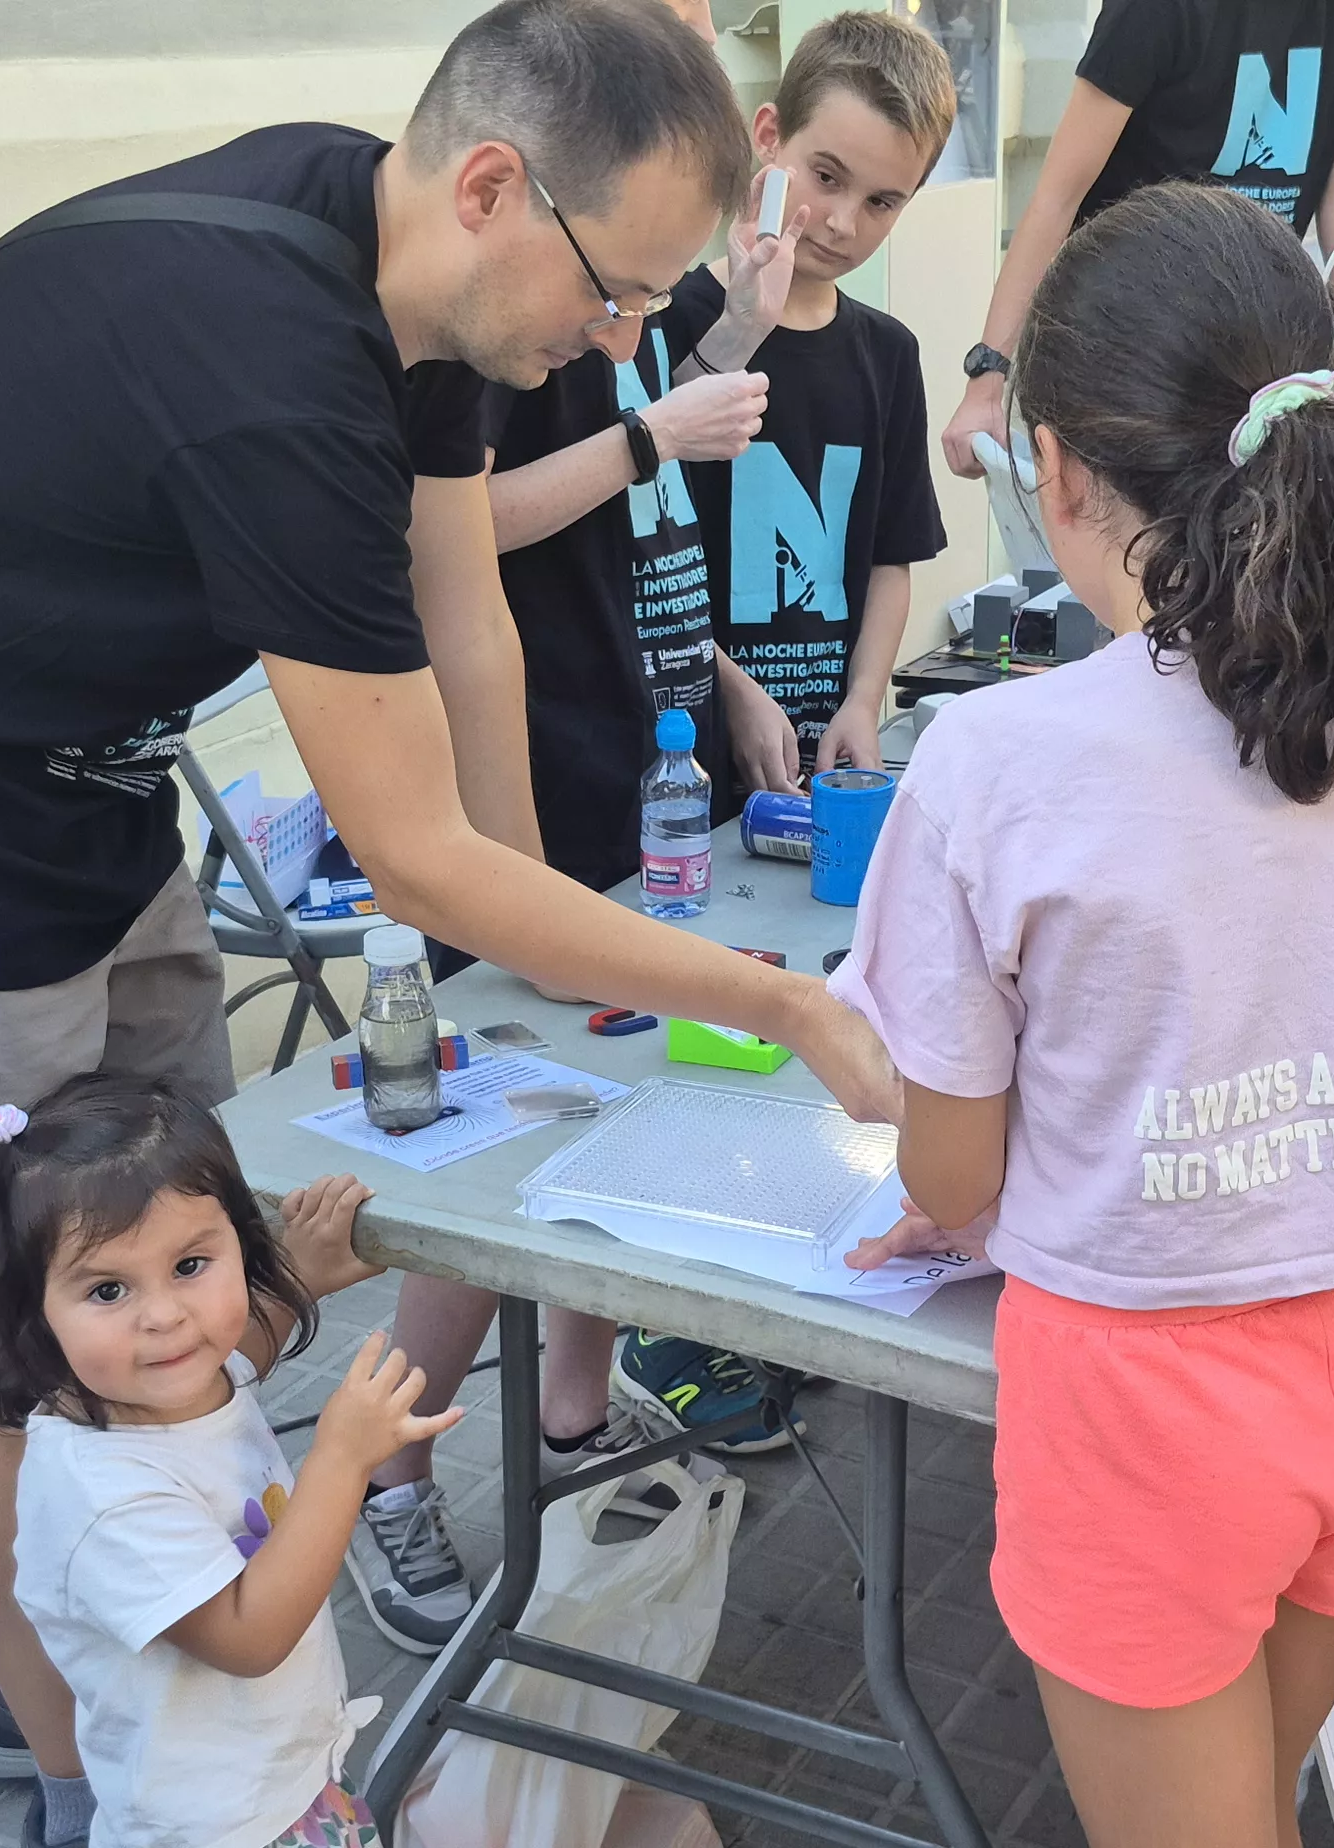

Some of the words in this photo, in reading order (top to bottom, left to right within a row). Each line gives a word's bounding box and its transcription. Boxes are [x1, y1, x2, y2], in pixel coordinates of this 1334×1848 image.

[1210, 47, 1322, 176] N
[730, 441, 862, 625] N
[632, 560, 653, 577] LA
[633, 602, 644, 620] E
[729, 644, 749, 659] LA
[753, 642, 805, 659] NOCHE
[1133, 1058, 1298, 1142] ALWAYS
[1141, 1152, 1208, 1202] NO
